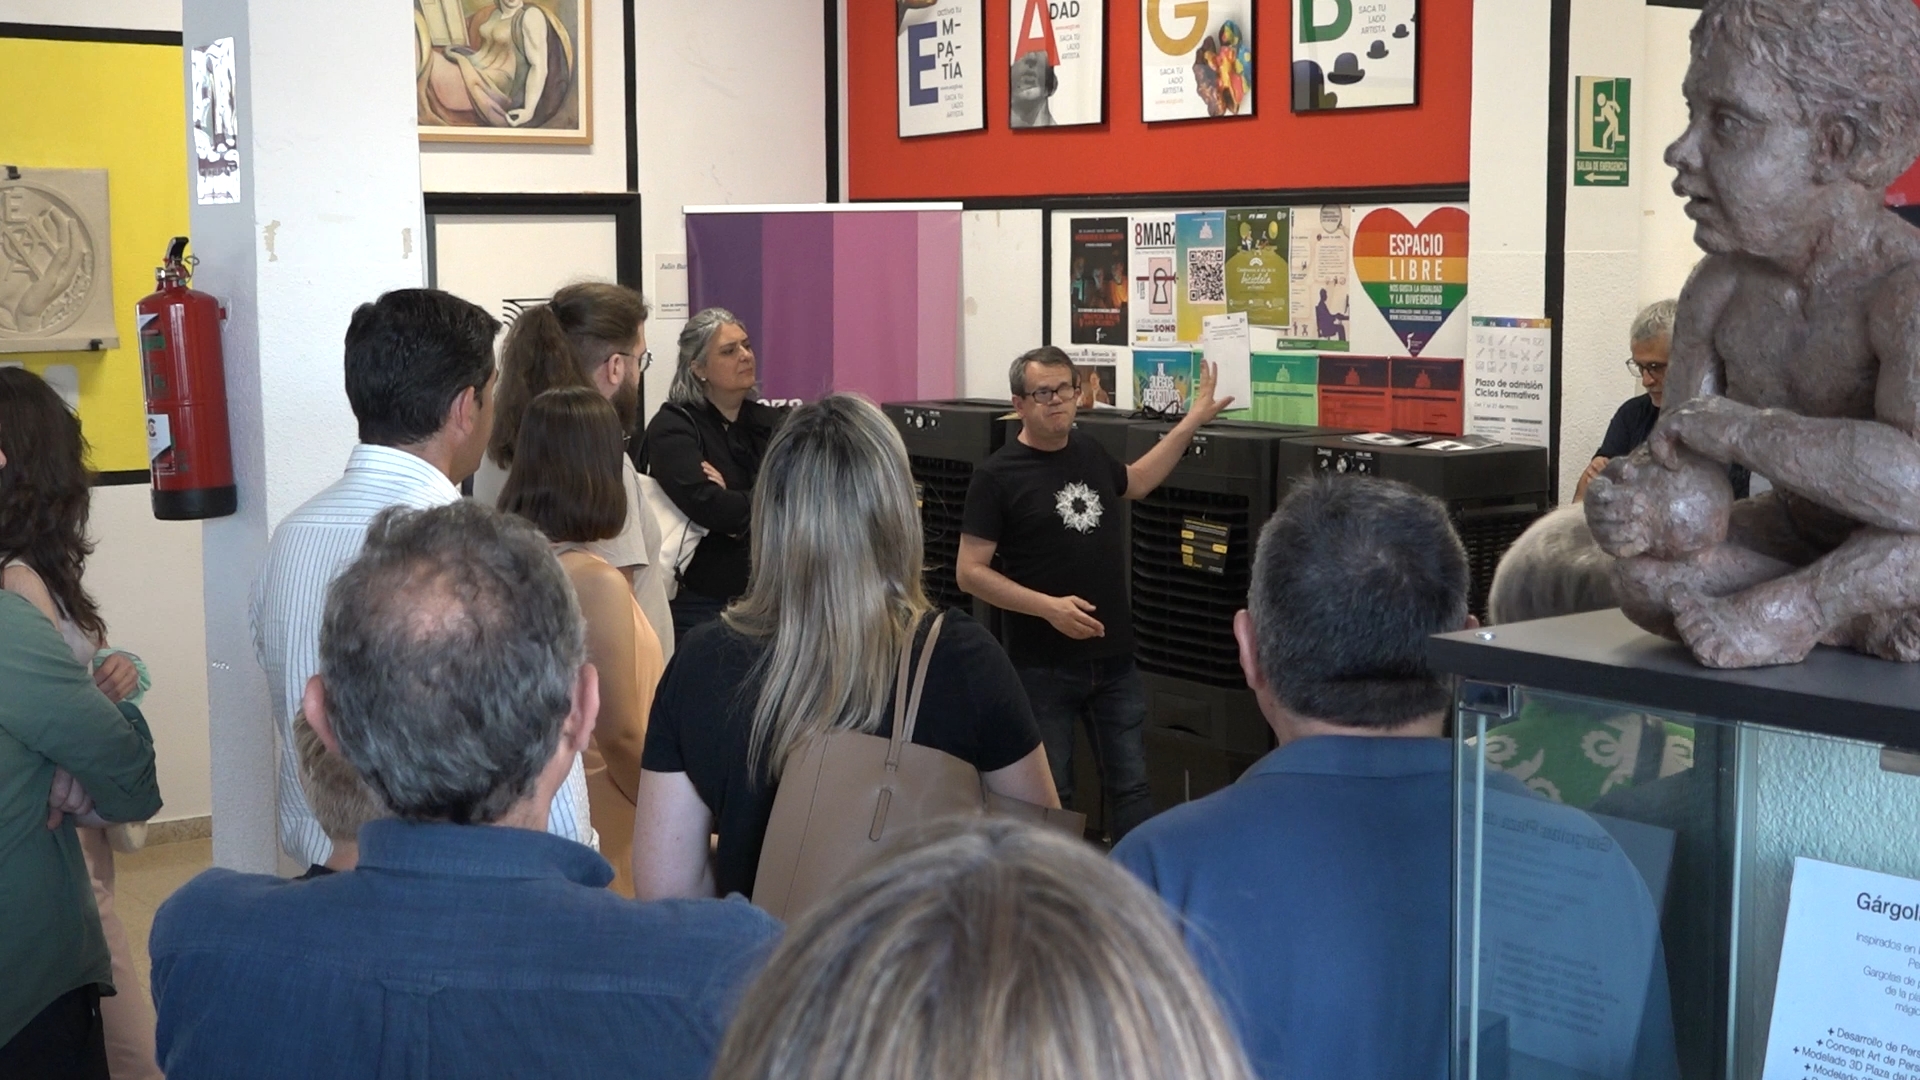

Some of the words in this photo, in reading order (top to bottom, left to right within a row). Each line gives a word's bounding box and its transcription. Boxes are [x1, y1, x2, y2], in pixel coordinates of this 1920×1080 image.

[1050, 1, 1080, 20] DAD
[1358, 5, 1376, 14] SACA
[1368, 14, 1386, 23] LADO
[942, 18, 961, 36] M-
[1014, 0, 1060, 66] A
[1146, 0, 1209, 56] G
[1361, 25, 1386, 34] ARTISTA
[937, 40, 961, 59] PA-
[908, 21, 938, 106] E
[942, 58, 963, 80] TÍA
[1160, 68, 1175, 76] SACA
[1168, 76, 1184, 84] LADO
[1162, 86, 1184, 94] ARTISTA
[1577, 160, 1592, 171] SALIDA
[1593, 160, 1599, 170] DE
[1600, 161, 1627, 171] EMERGENCIA
[1389, 234, 1444, 256] ESPACIO
[1389, 259, 1443, 281] LIBRE
[1414, 285, 1419, 293] LA
[1389, 294, 1394, 304] Y
[1396, 294, 1404, 305] LA
[1405, 294, 1442, 305] DIVERSIDAD
[1476, 378, 1495, 387] Plazo
[1497, 379, 1507, 387] de
[1509, 380, 1543, 390] admisión
[1475, 388, 1498, 397] Ciclos
[1501, 389, 1540, 400] Formativos
[1857, 892, 1920, 922] Gárgol
[1856, 932, 1901, 951] Inspirados
[1904, 945, 1916, 954] en
[1904, 976, 1915, 986] de
[1885, 986, 1896, 996] de
[1899, 988, 1906, 998] la
[1837, 1028, 1882, 1048] Desarrollo
[1885, 1042, 1897, 1052] de
[1826, 1039, 1865, 1058] Concept
[1867, 1050, 1881, 1062] Art
[1883, 1055, 1895, 1067] de
[1802, 1047, 1846, 1067] Modelado
[1849, 1059, 1863, 1071] 3D
[1865, 1064, 1890, 1079] Plaza
